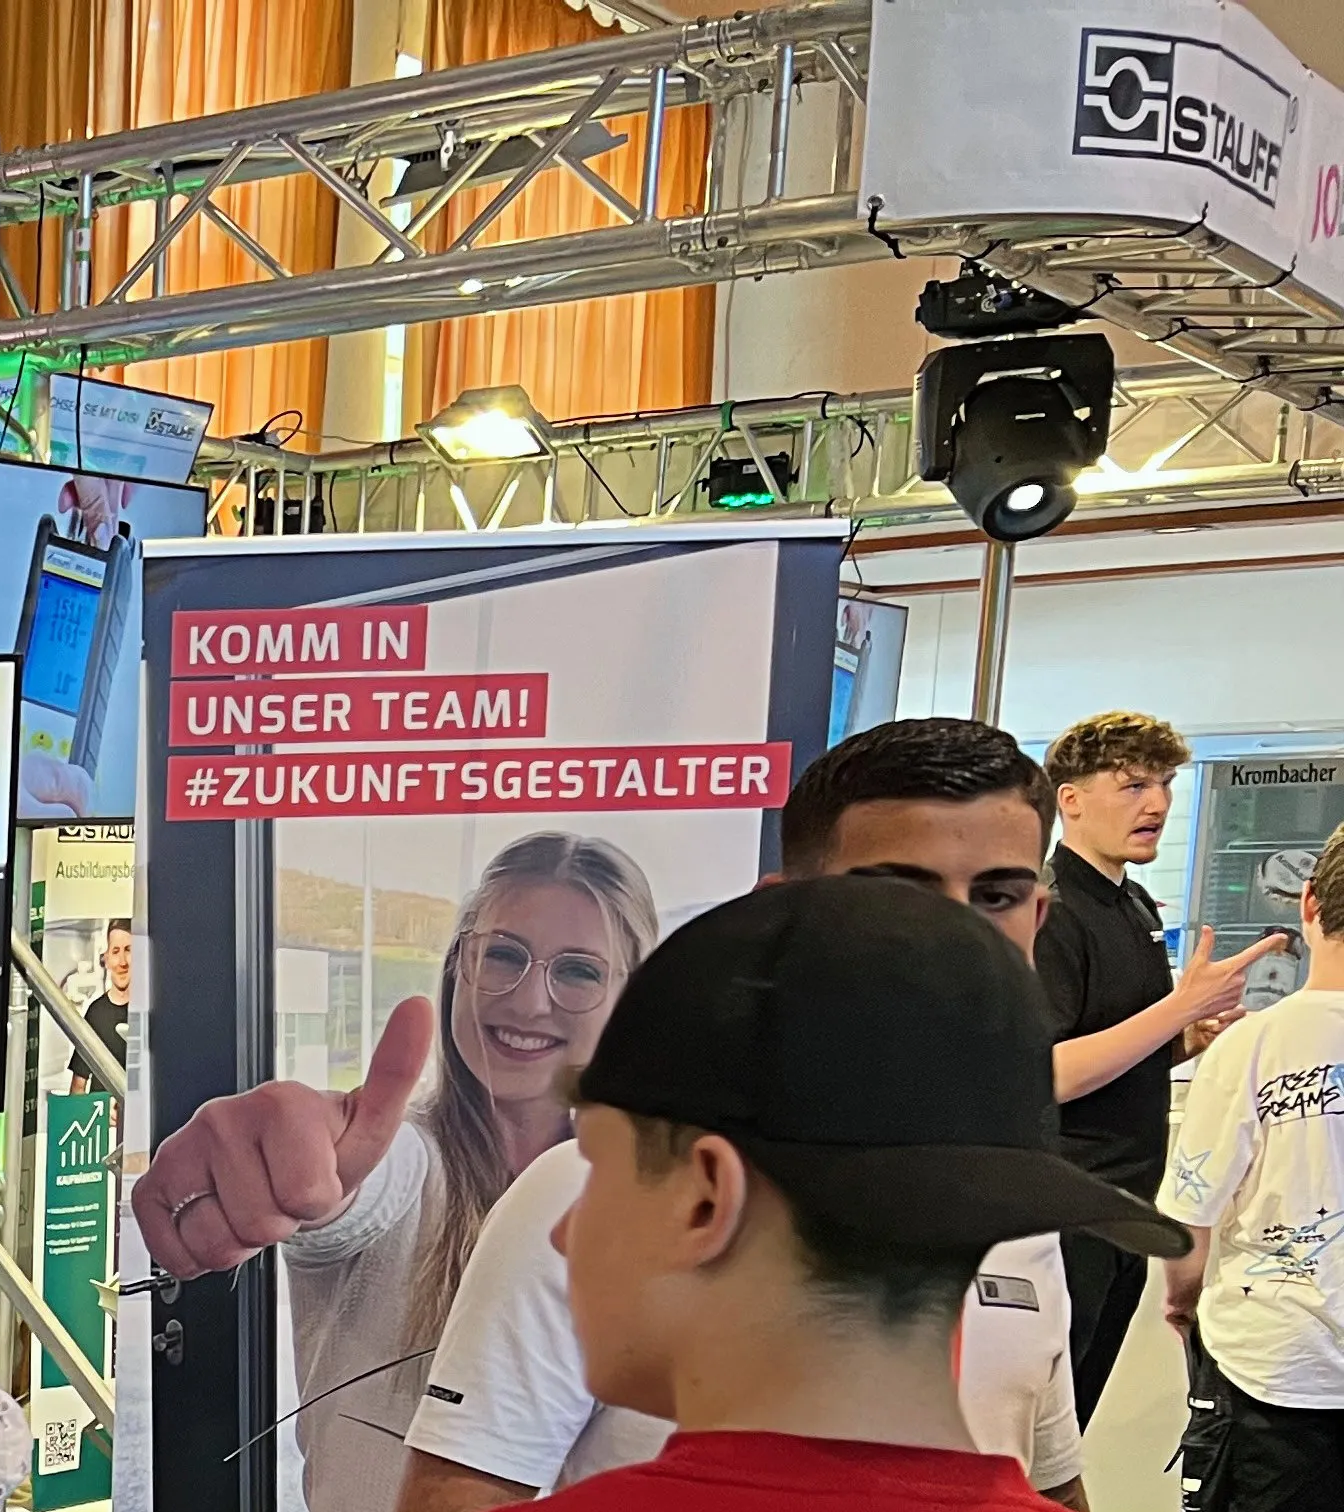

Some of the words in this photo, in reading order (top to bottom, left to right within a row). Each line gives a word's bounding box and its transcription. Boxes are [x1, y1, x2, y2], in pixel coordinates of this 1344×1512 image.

[1173, 98, 1282, 192] STAUFF
[188, 621, 340, 666] KOMM
[362, 620, 409, 661] IN
[186, 693, 351, 736] UNSER
[372, 687, 530, 732] TEAM!
[184, 755, 771, 807] #ZUKUNFTSGESTALTER
[1231, 763, 1337, 786] Krombacher
